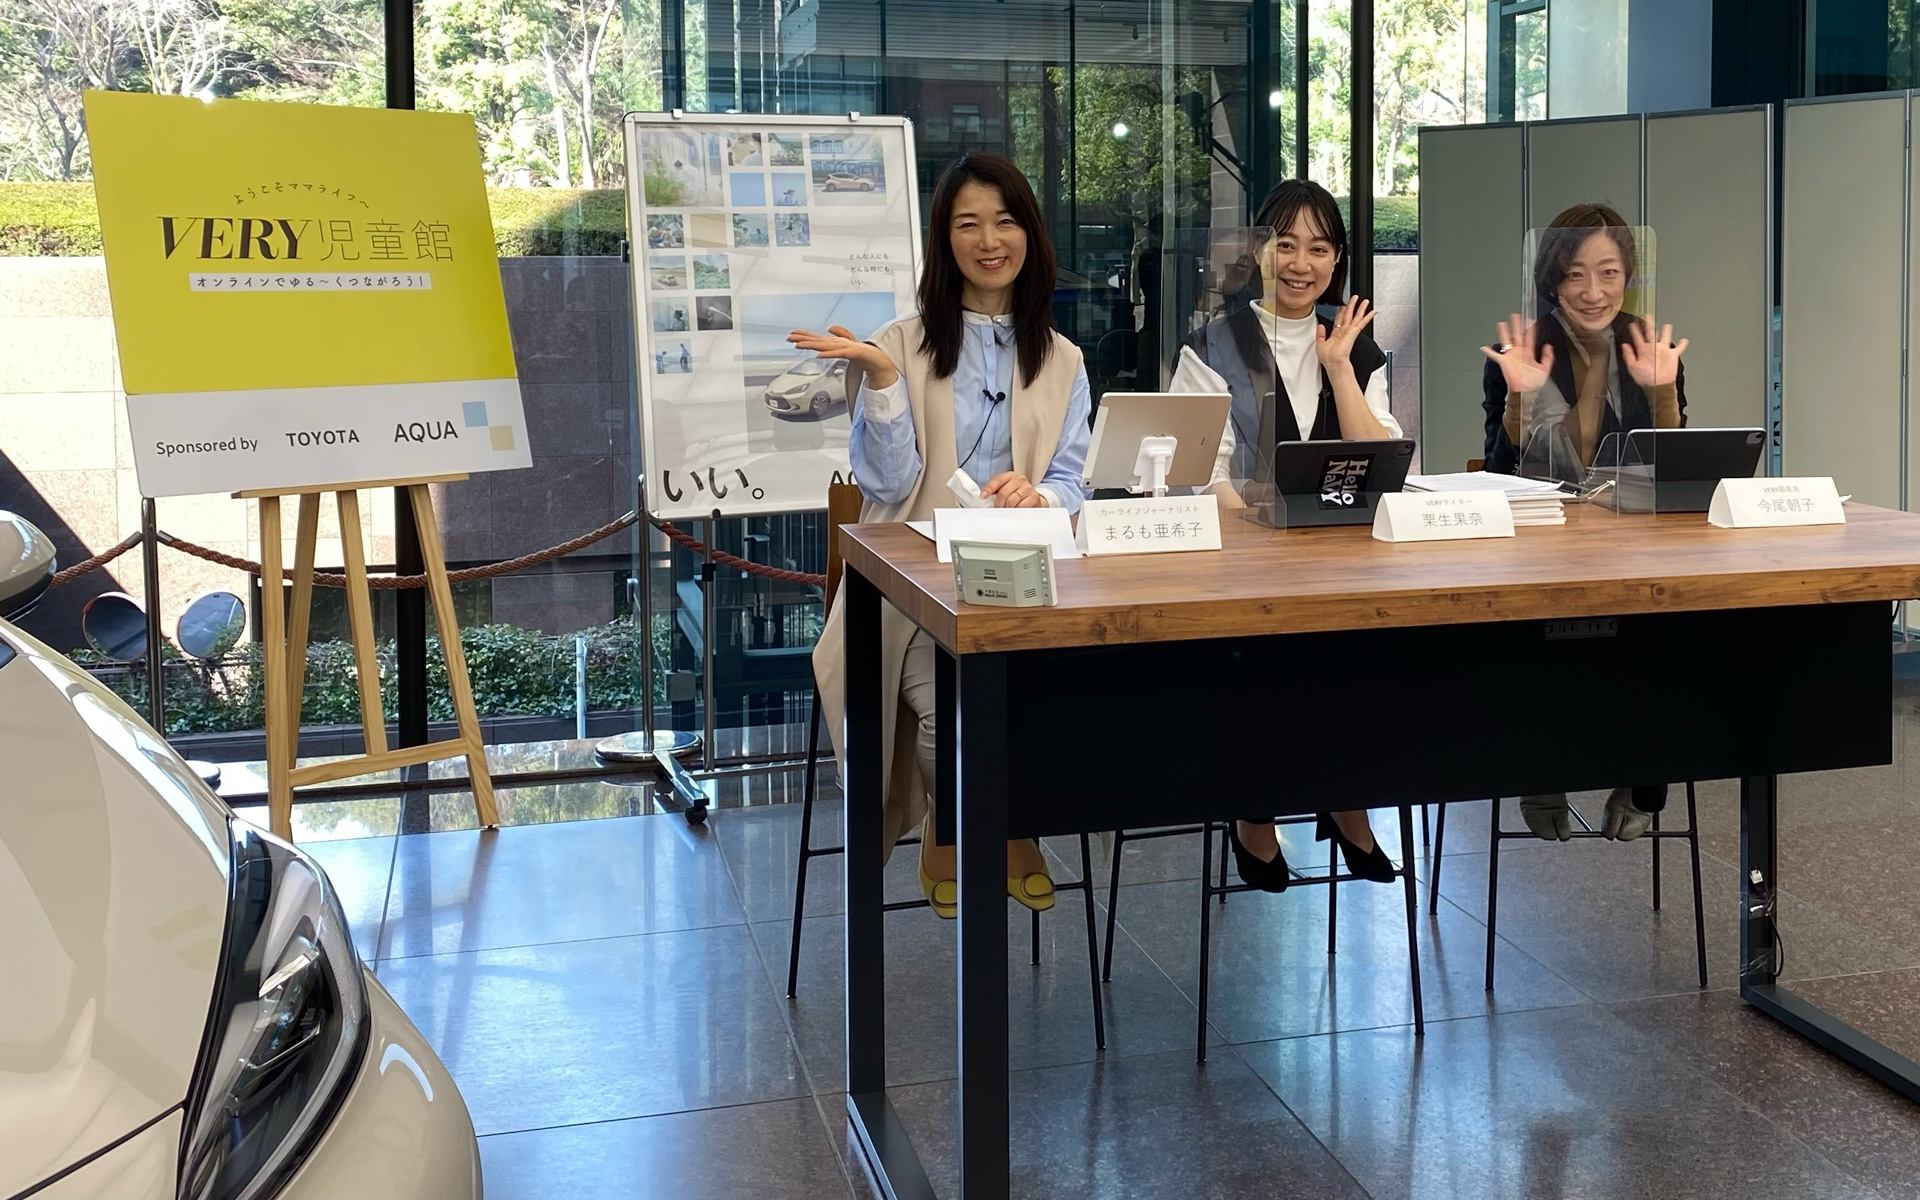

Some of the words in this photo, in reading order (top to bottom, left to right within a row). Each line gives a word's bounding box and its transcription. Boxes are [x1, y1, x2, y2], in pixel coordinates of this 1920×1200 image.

[234, 182, 369, 209] ようこそママライフへ
[156, 216, 454, 262] VERY児童館
[285, 429, 360, 447] TOYOTA
[394, 420, 459, 443] AQUA
[156, 437, 237, 457] Sponsored
[239, 437, 258, 452] by
[663, 467, 764, 502] いい。
[1341, 459, 1369, 505] Hello
[1100, 504, 1199, 517] カーライフジャーナリスト
[1757, 498, 1815, 513] 今尾朝子
[1421, 512, 1484, 528] 栗生果奈
[1105, 522, 1203, 541] まるも亜希子
